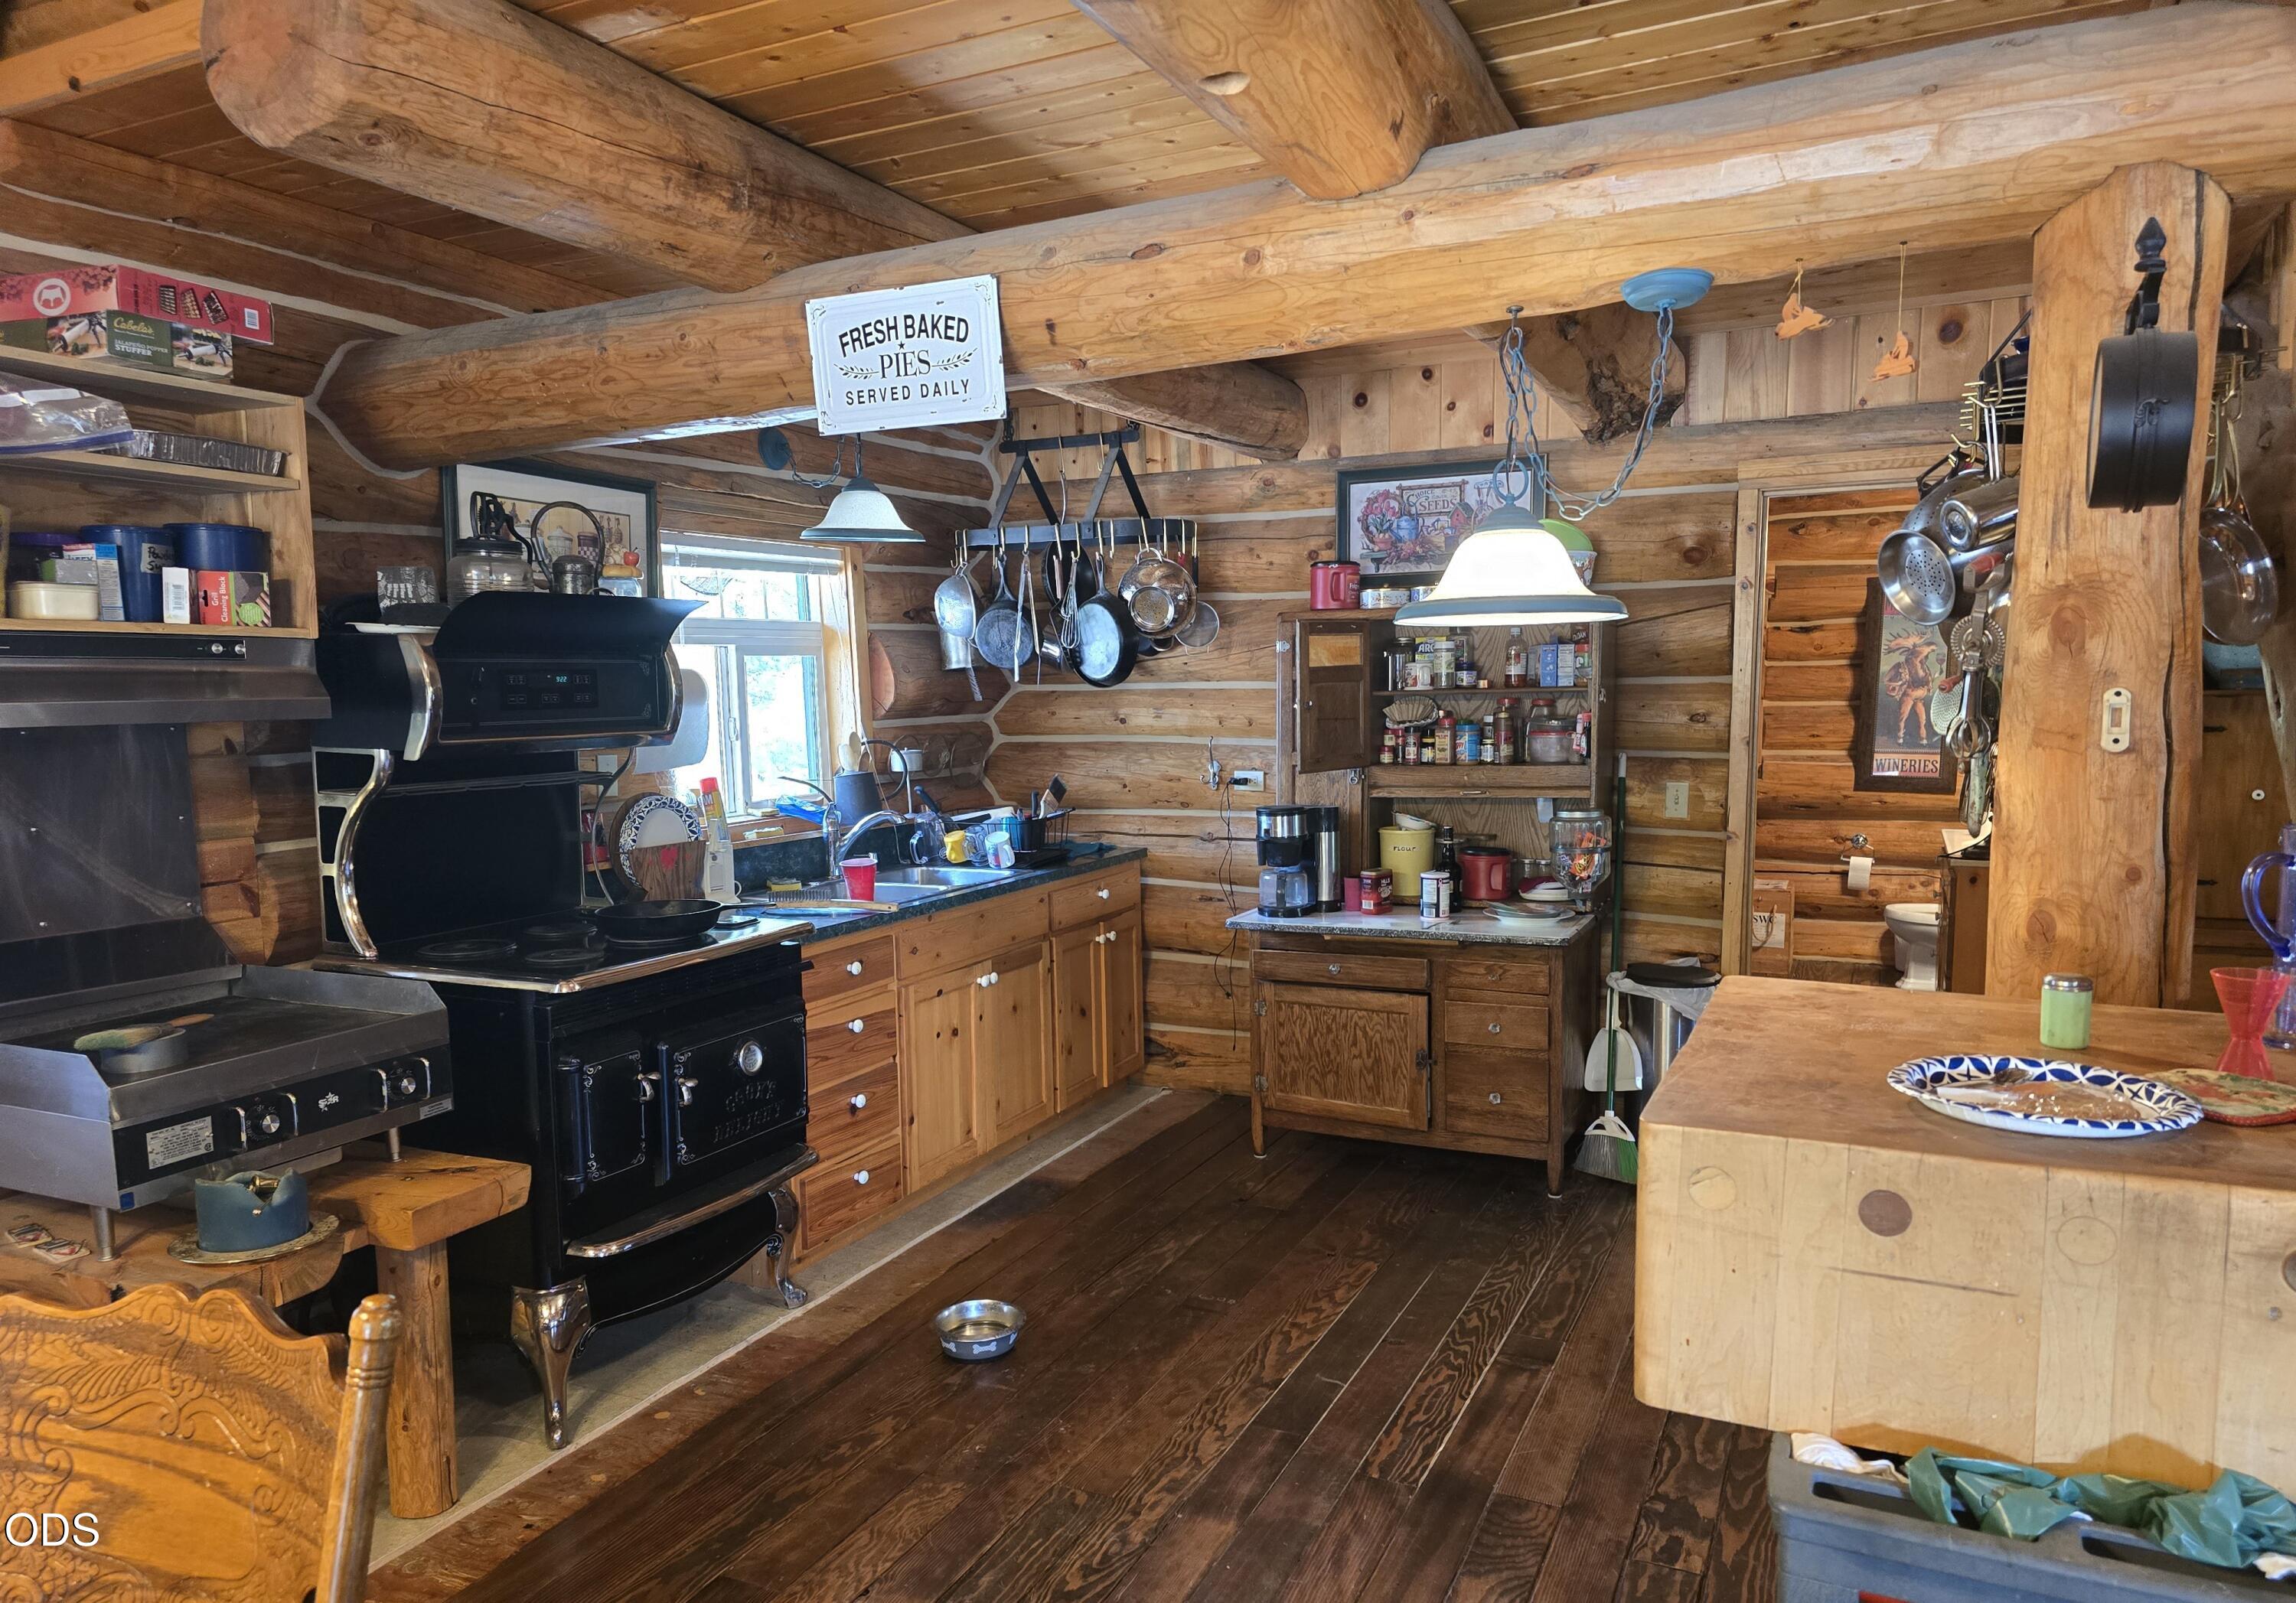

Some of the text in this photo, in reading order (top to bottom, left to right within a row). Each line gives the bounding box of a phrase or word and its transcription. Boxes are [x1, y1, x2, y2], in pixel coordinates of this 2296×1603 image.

[838, 314, 969, 357] FRESH BAKED
[114, 344, 153, 357] STUFFER
[879, 349, 931, 380] PIES
[845, 379, 970, 406] SERVED DAILY
[1419, 498, 1457, 511] SEEDS
[218, 575, 229, 623] Cleaning Block
[1874, 758, 1939, 774] WINERIES
